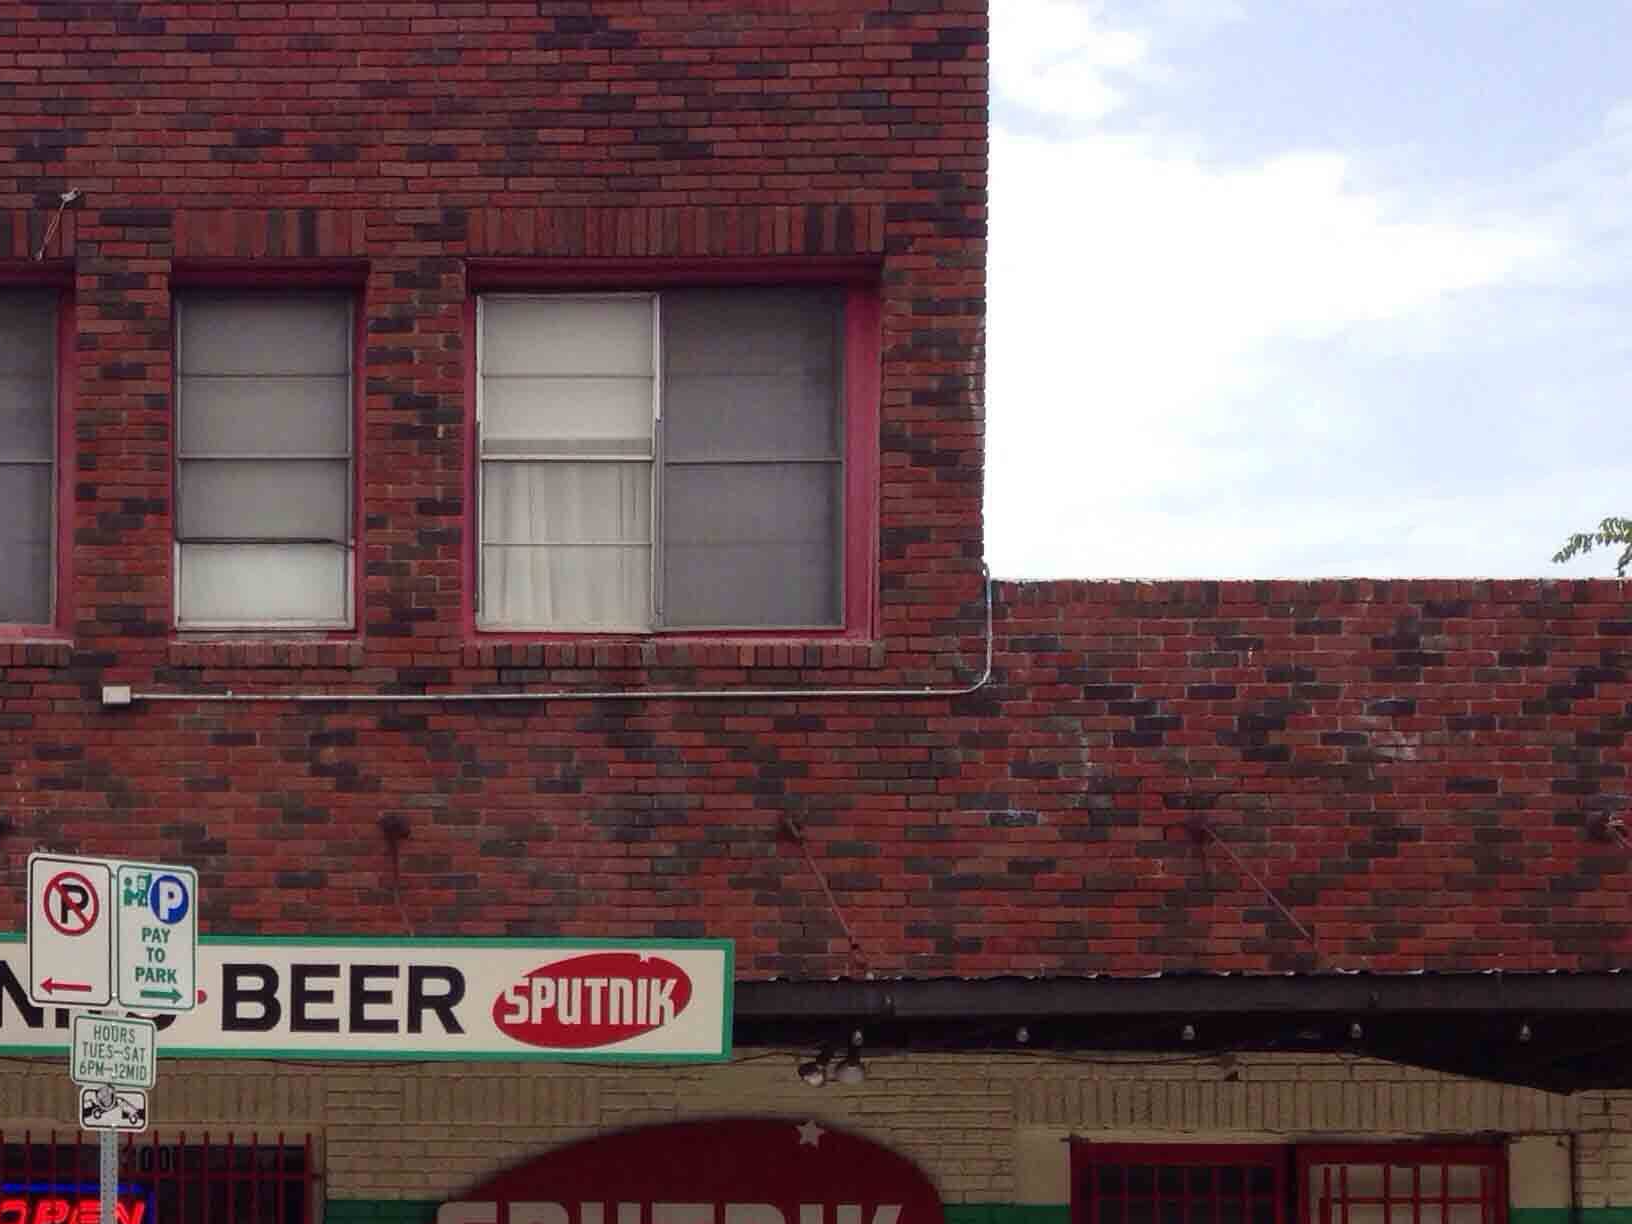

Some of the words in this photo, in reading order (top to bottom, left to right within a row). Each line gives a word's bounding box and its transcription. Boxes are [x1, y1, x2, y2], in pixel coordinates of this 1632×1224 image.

[159, 880, 185, 921] P
[141, 926, 170, 943] PAY
[147, 947, 166, 963] TO
[135, 967, 177, 984] PARK
[221, 962, 466, 1034] BEER
[504, 976, 677, 1026] SPUTNIK
[93, 1024, 136, 1044] HOURS
